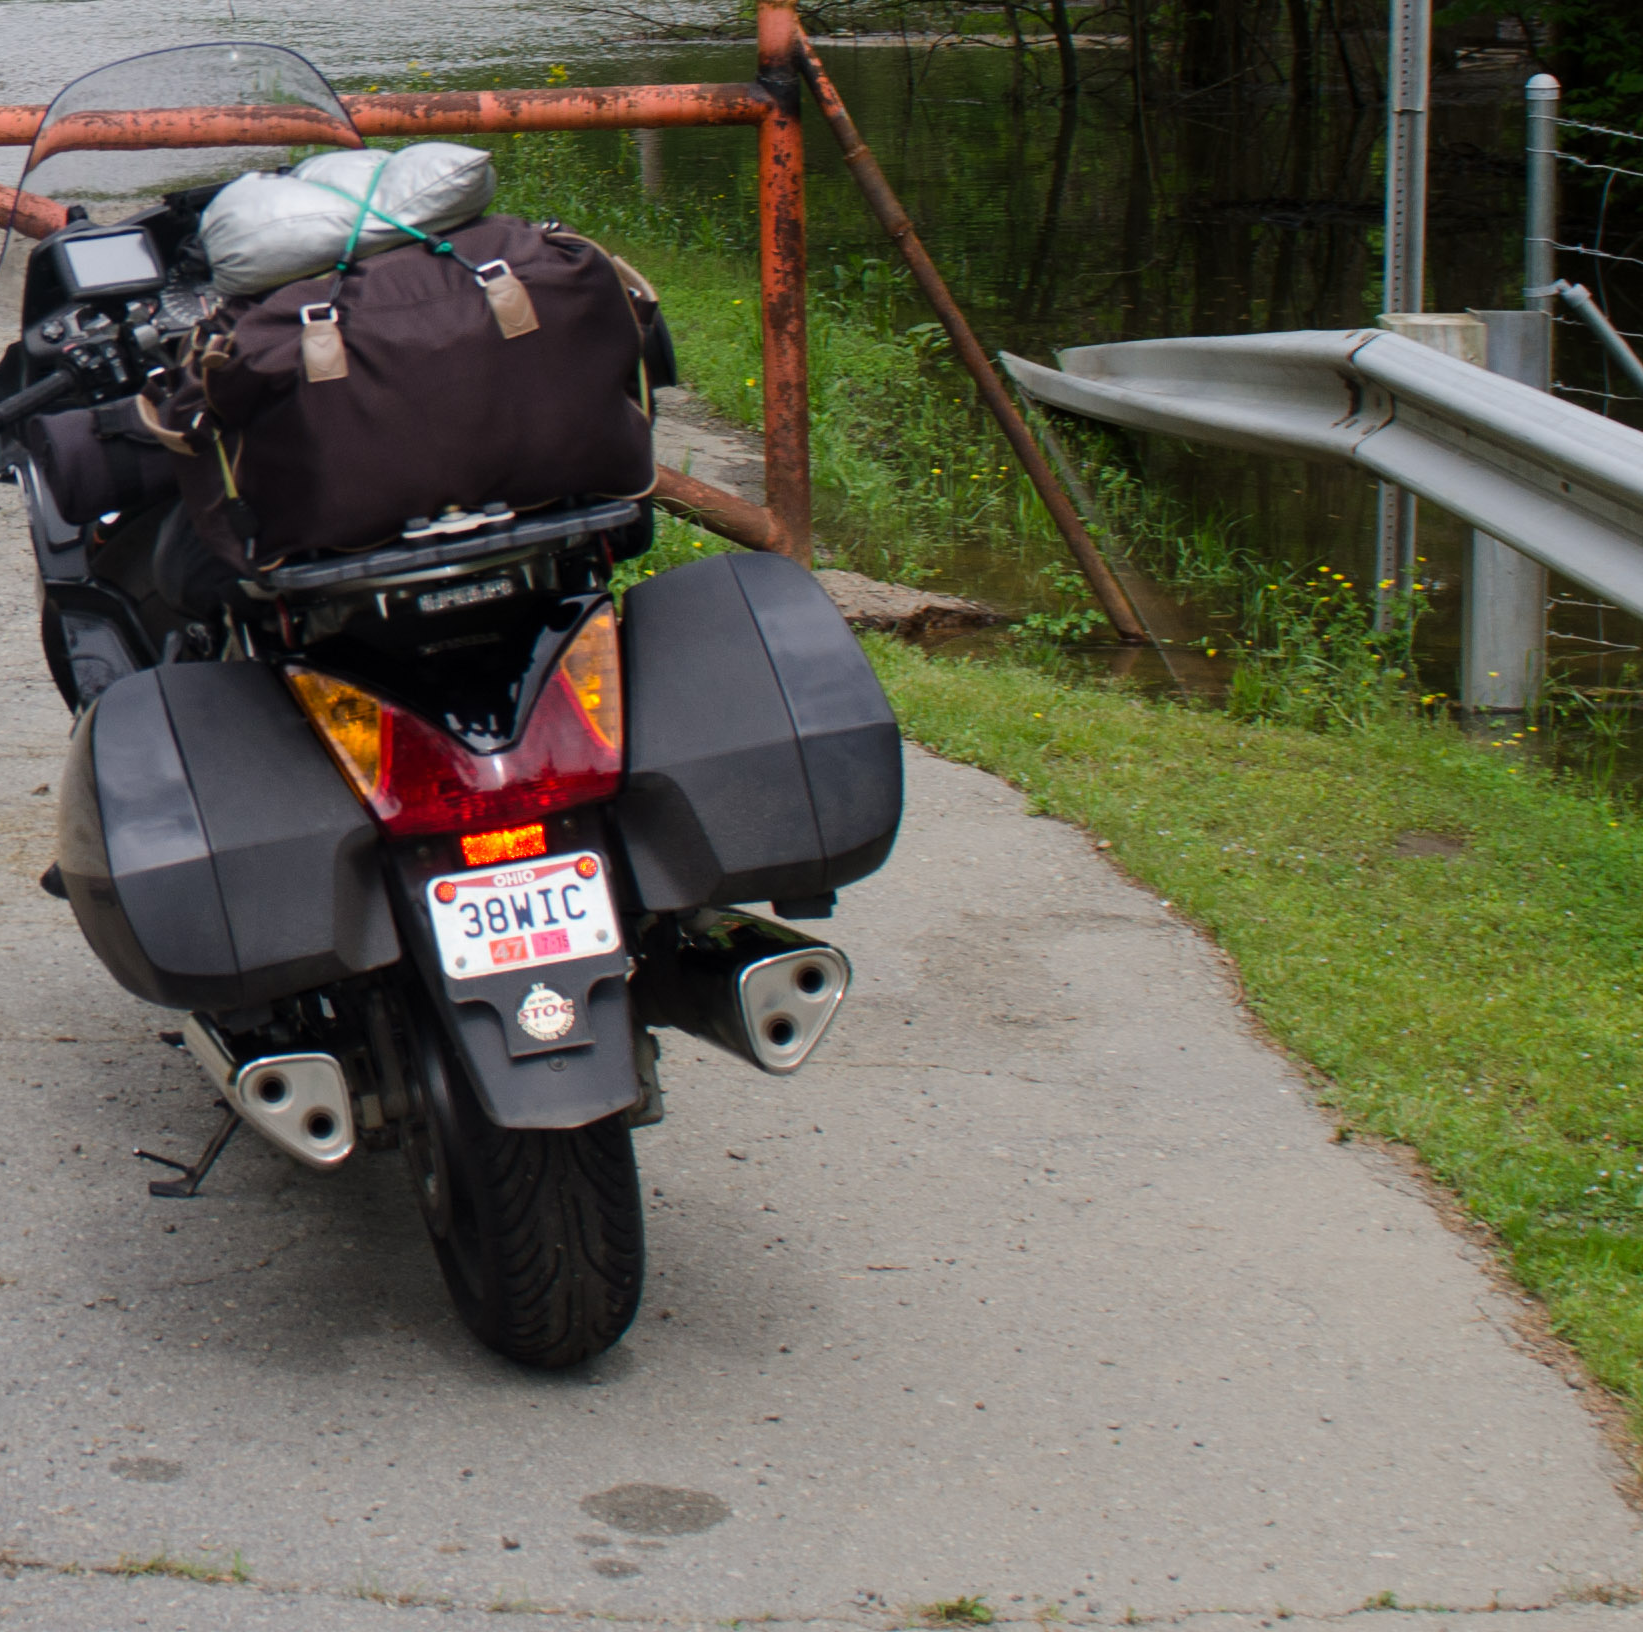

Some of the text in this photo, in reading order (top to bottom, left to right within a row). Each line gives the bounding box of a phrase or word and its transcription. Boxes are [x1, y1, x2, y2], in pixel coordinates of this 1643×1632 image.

[493, 869, 536, 888] OHIO
[459, 884, 587, 938] 38WIC
[495, 942, 524, 960] 47
